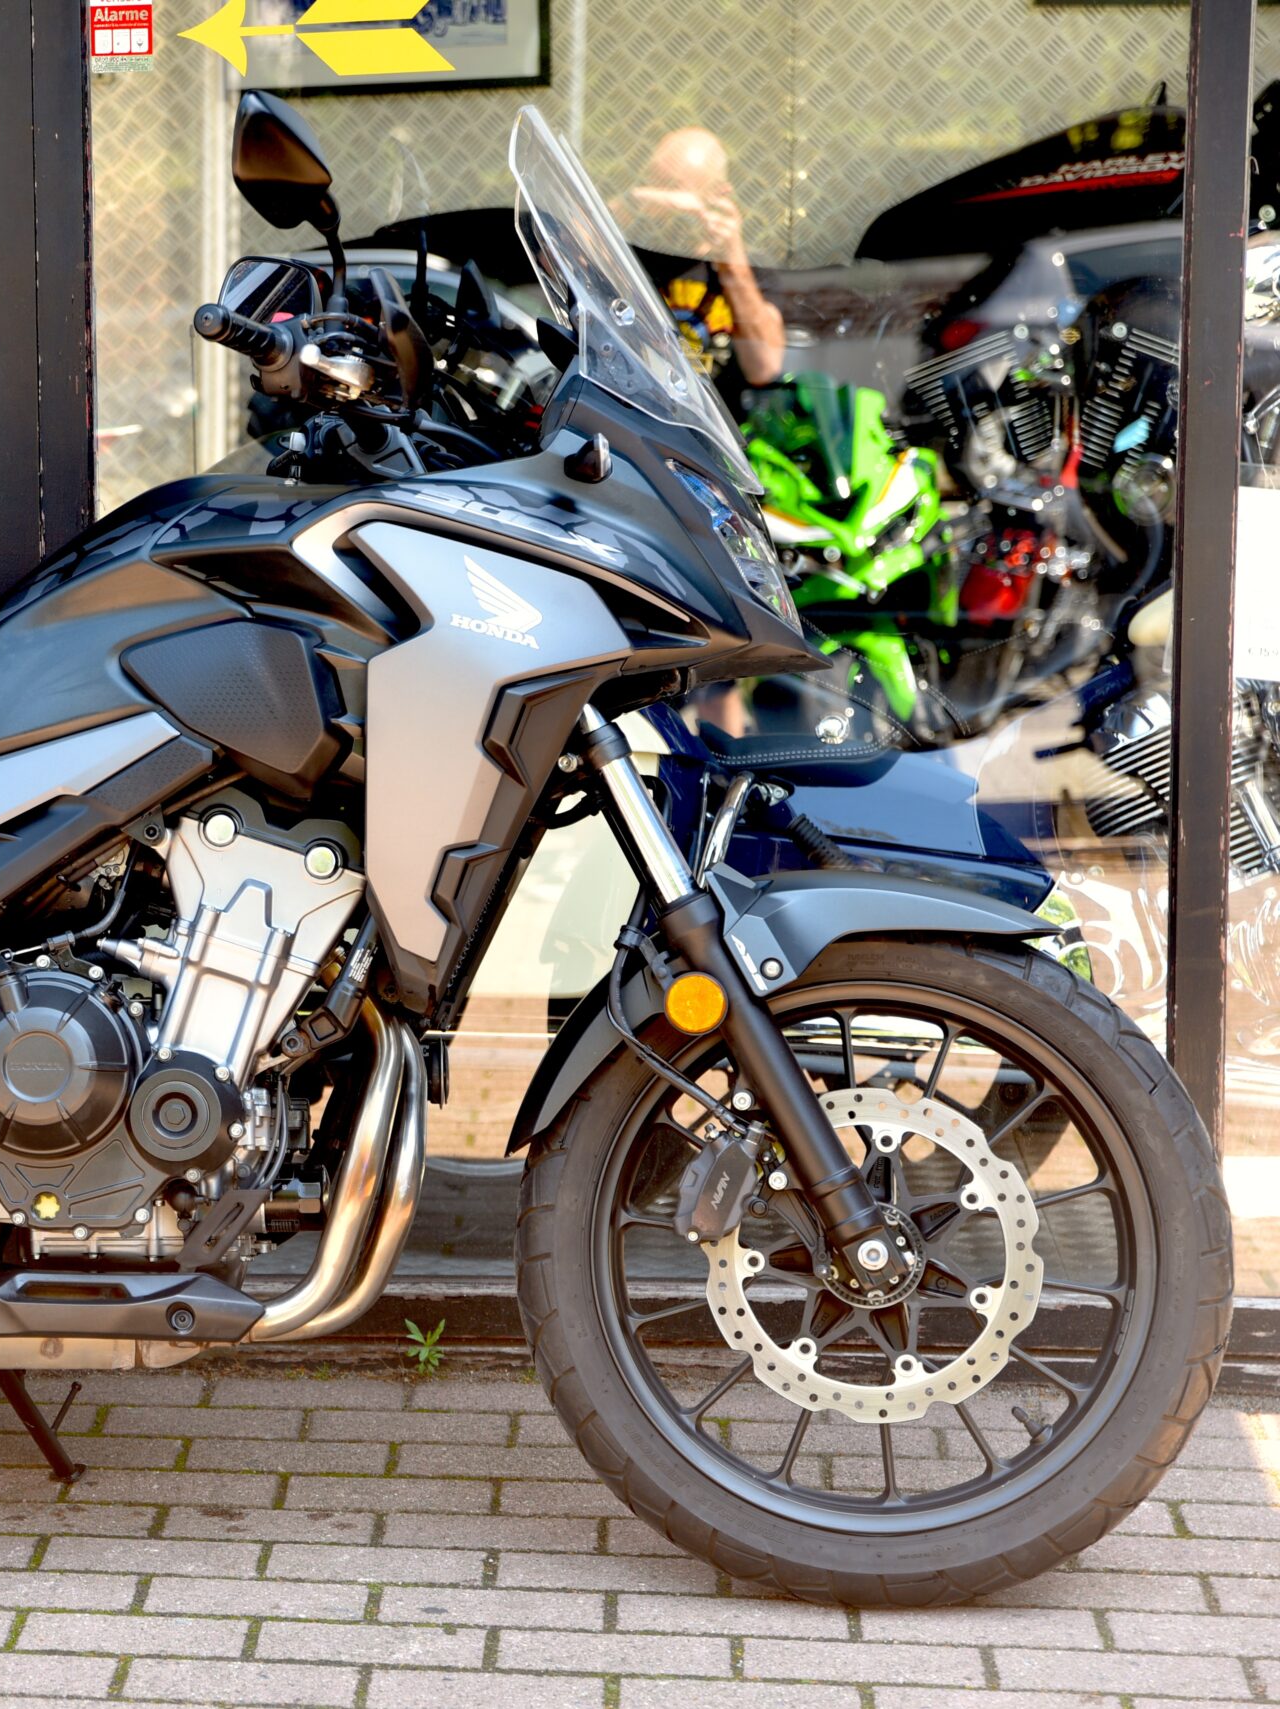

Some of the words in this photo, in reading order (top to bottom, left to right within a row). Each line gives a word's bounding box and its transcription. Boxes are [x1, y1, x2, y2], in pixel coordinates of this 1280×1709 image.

[93, 7, 149, 22] Alarme
[1020, 158, 1186, 188] DAVIDSON
[1057, 151, 1186, 175] HARLEY
[450, 612, 540, 651] HONDA
